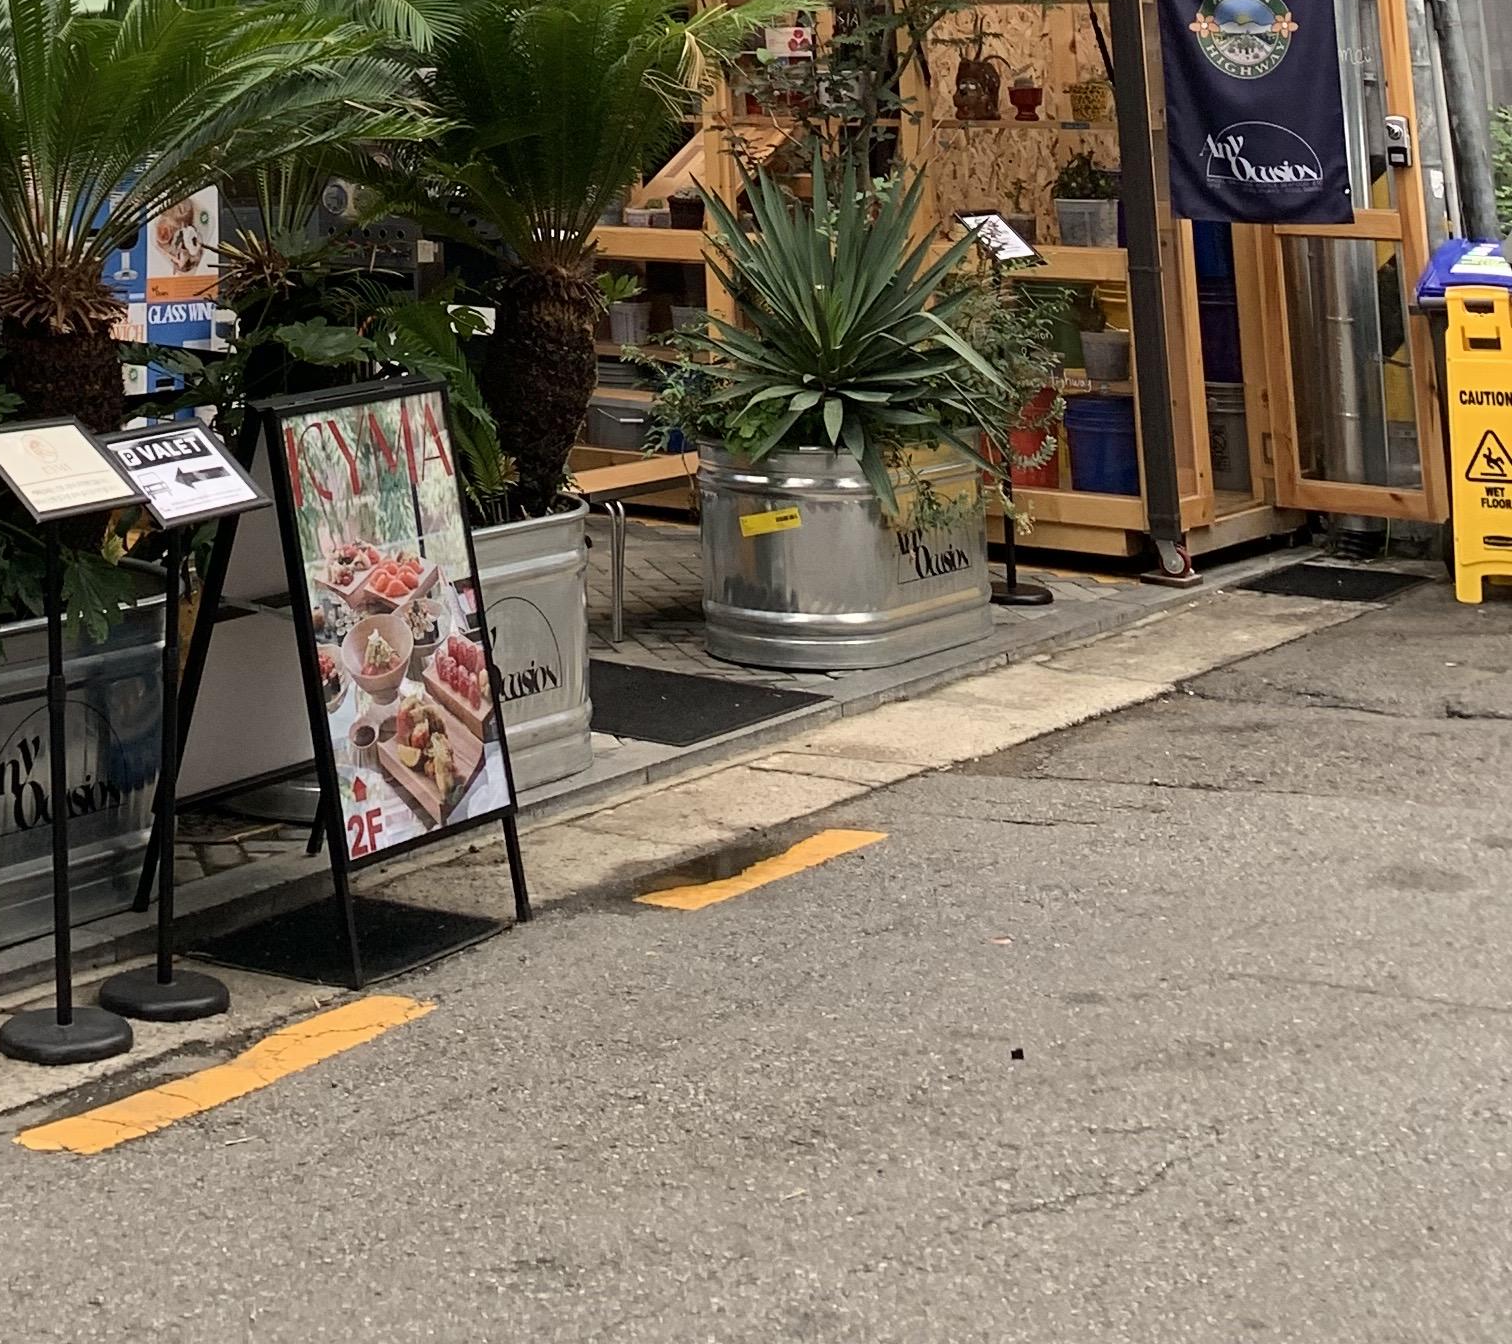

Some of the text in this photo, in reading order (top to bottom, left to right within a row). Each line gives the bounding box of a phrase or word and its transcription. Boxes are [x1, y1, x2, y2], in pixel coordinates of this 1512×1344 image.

[1205, 40, 1285, 76] HIGHWAY
[1199, 133, 1244, 160] Any
[147, 303, 187, 325] GLASS
[135, 436, 202, 462] VALET
[284, 402, 453, 508] KYMA
[1484, 486, 1506, 498] WET
[346, 808, 384, 858] 2F
